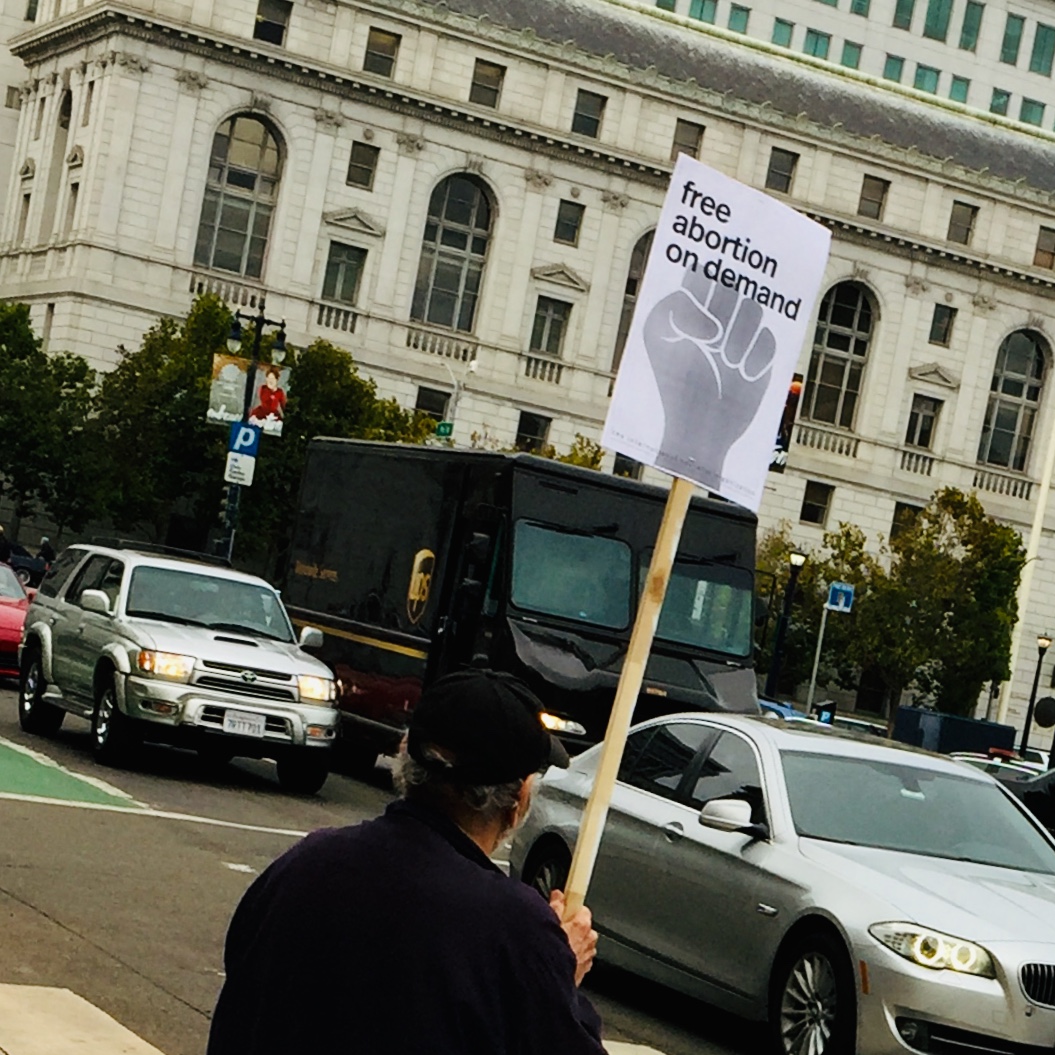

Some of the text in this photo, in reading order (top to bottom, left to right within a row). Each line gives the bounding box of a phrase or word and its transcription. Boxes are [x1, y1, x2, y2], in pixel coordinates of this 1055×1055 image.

[681, 181, 732, 224] free
[671, 214, 778, 278] abortion
[665, 242, 802, 321] on demand
